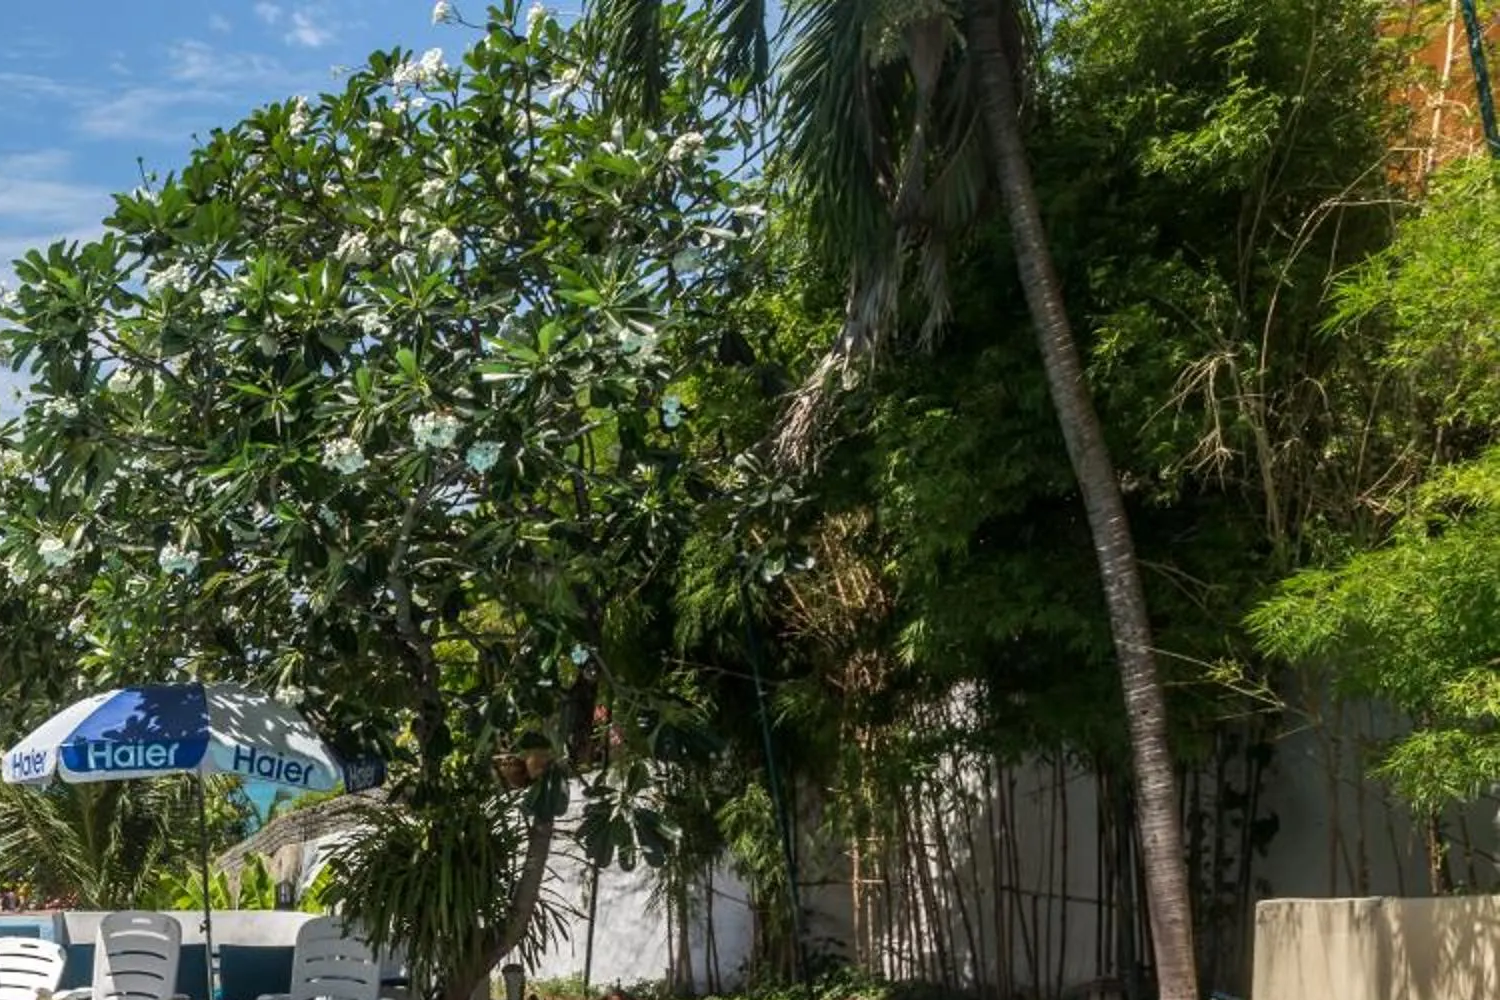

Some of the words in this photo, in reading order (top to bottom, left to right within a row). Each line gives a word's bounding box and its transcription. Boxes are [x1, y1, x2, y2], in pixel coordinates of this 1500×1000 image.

[12, 748, 48, 777] Haier
[87, 740, 180, 769] Haier
[233, 744, 315, 785] Haier
